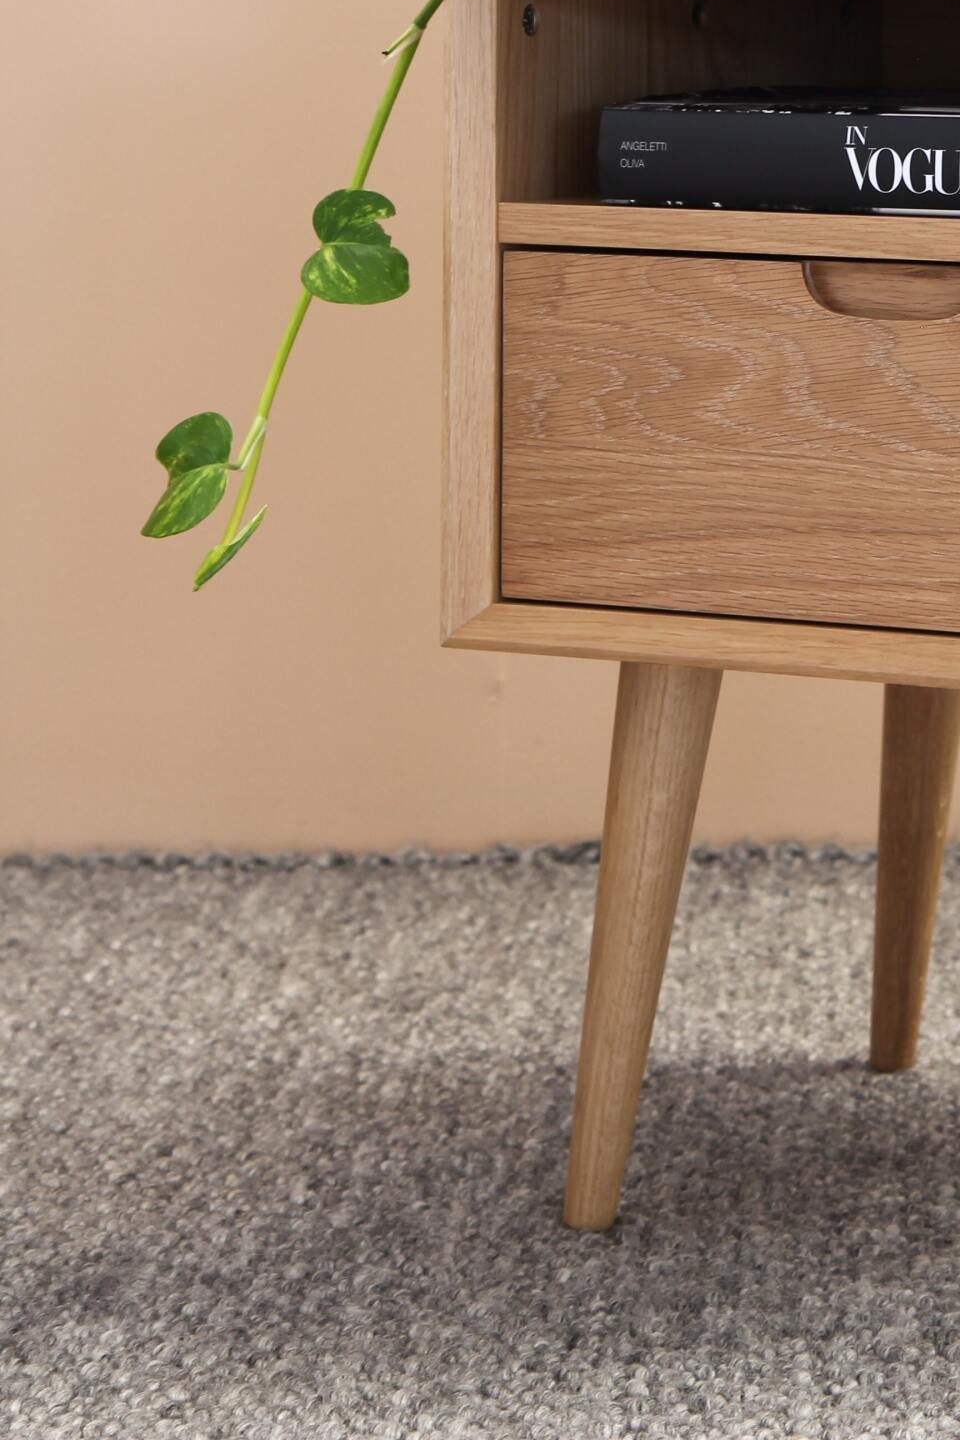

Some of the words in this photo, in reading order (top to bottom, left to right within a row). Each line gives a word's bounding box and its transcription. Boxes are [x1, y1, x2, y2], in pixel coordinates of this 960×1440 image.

[845, 125, 868, 145] IN
[620, 140, 667, 151] ANGELETTI
[619, 158, 645, 168] OLIVA
